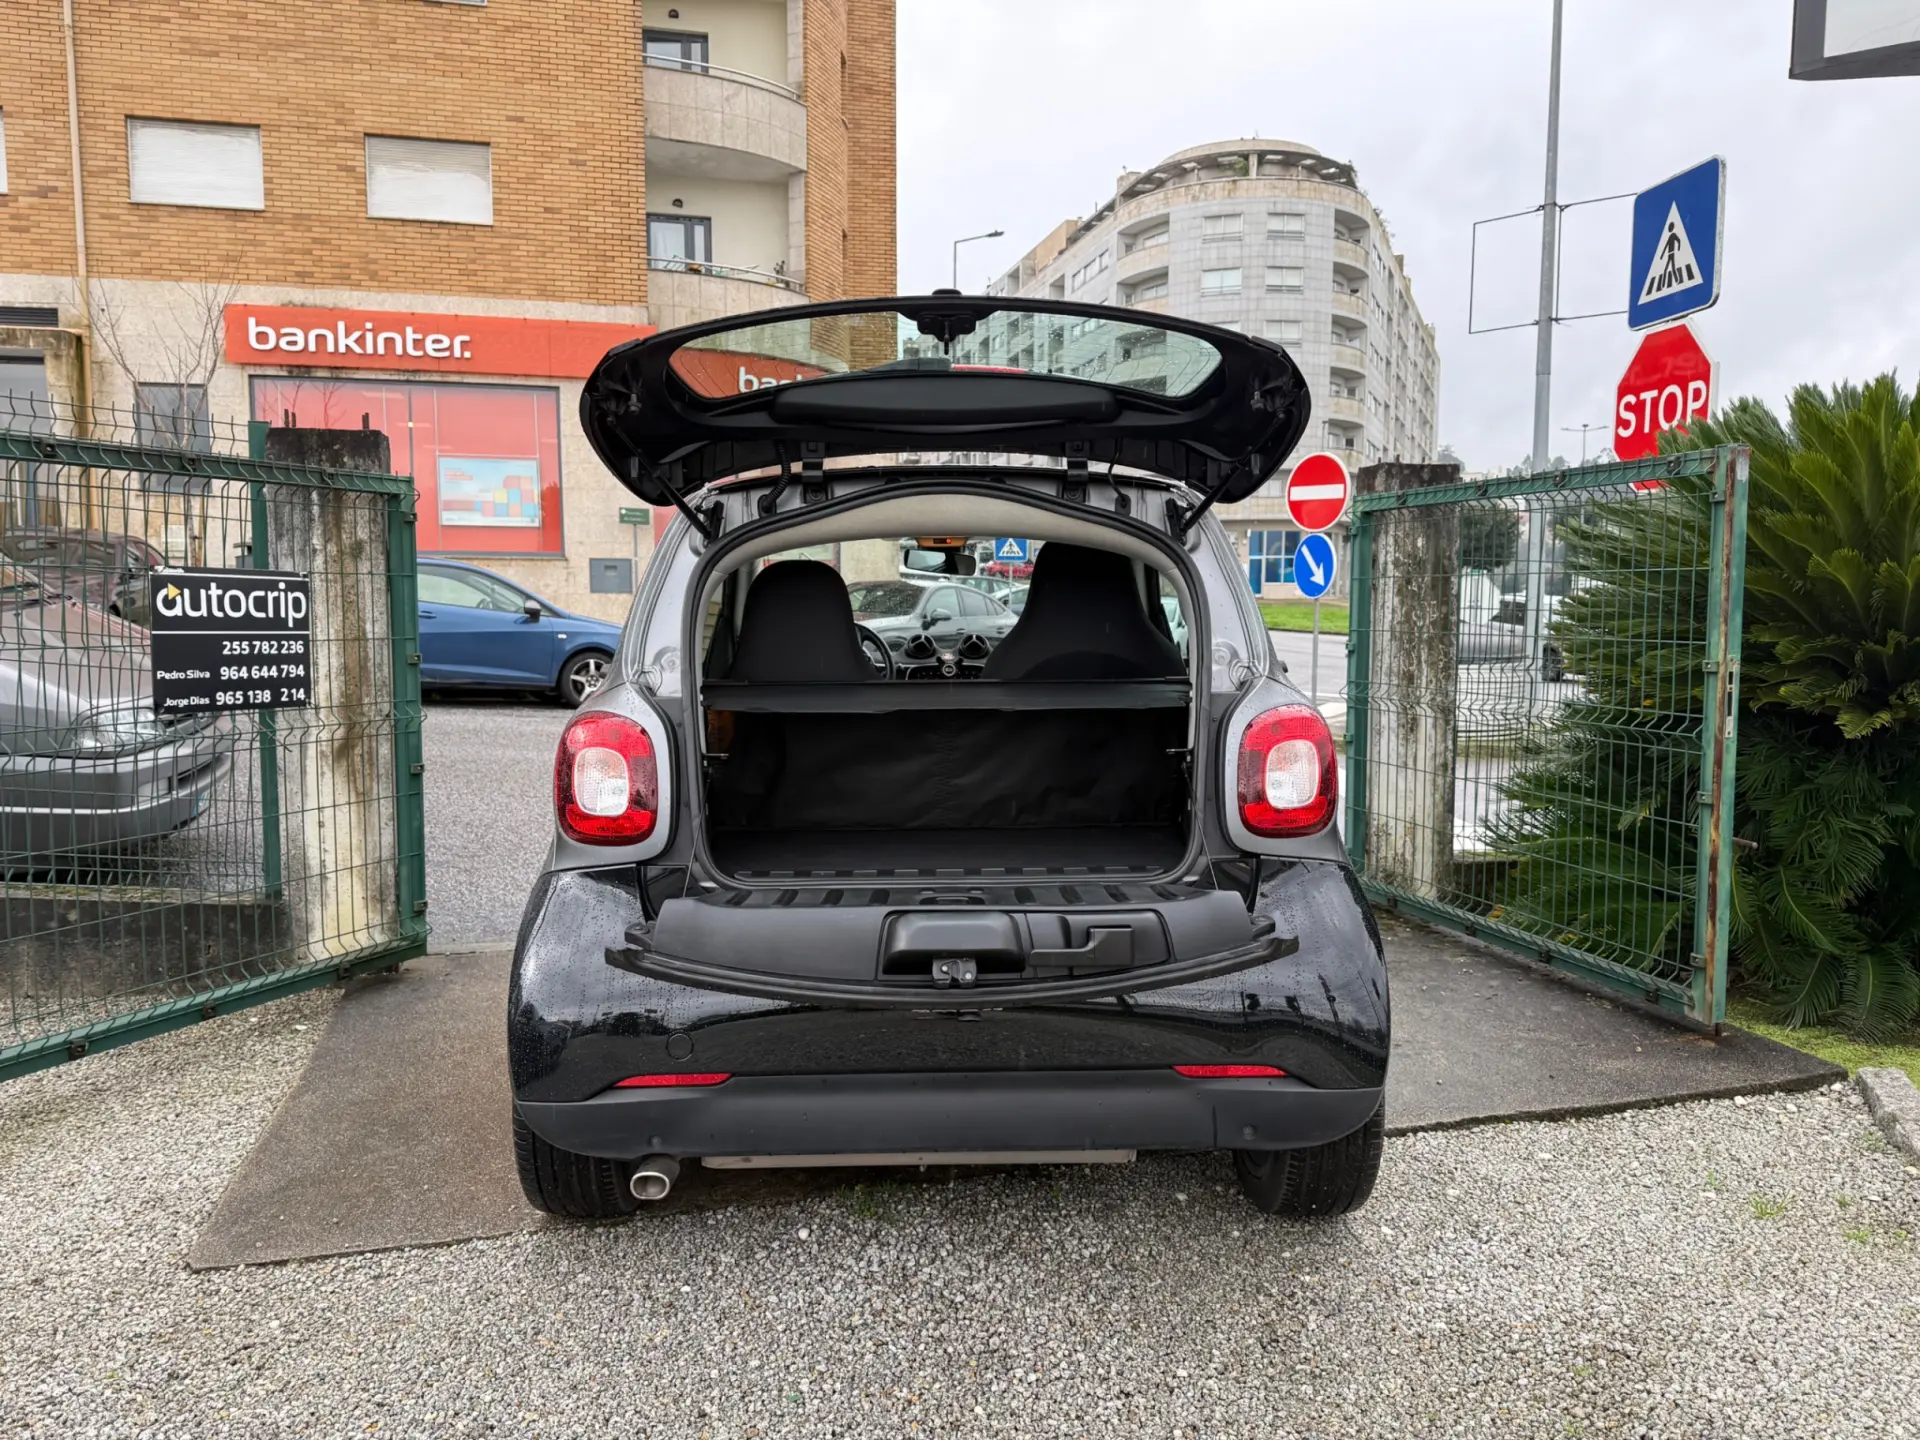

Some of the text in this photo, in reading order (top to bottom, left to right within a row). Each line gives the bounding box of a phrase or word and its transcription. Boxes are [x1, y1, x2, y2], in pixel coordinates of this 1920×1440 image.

[248, 317, 471, 358] bankinter.
[1617, 380, 1707, 438] STOP
[156, 582, 307, 628] autocrip
[222, 640, 304, 655] 255 782 236
[156, 664, 305, 680] Pedro Silva 964 644 794
[164, 688, 305, 707] Jorge Dias 965 138 214
